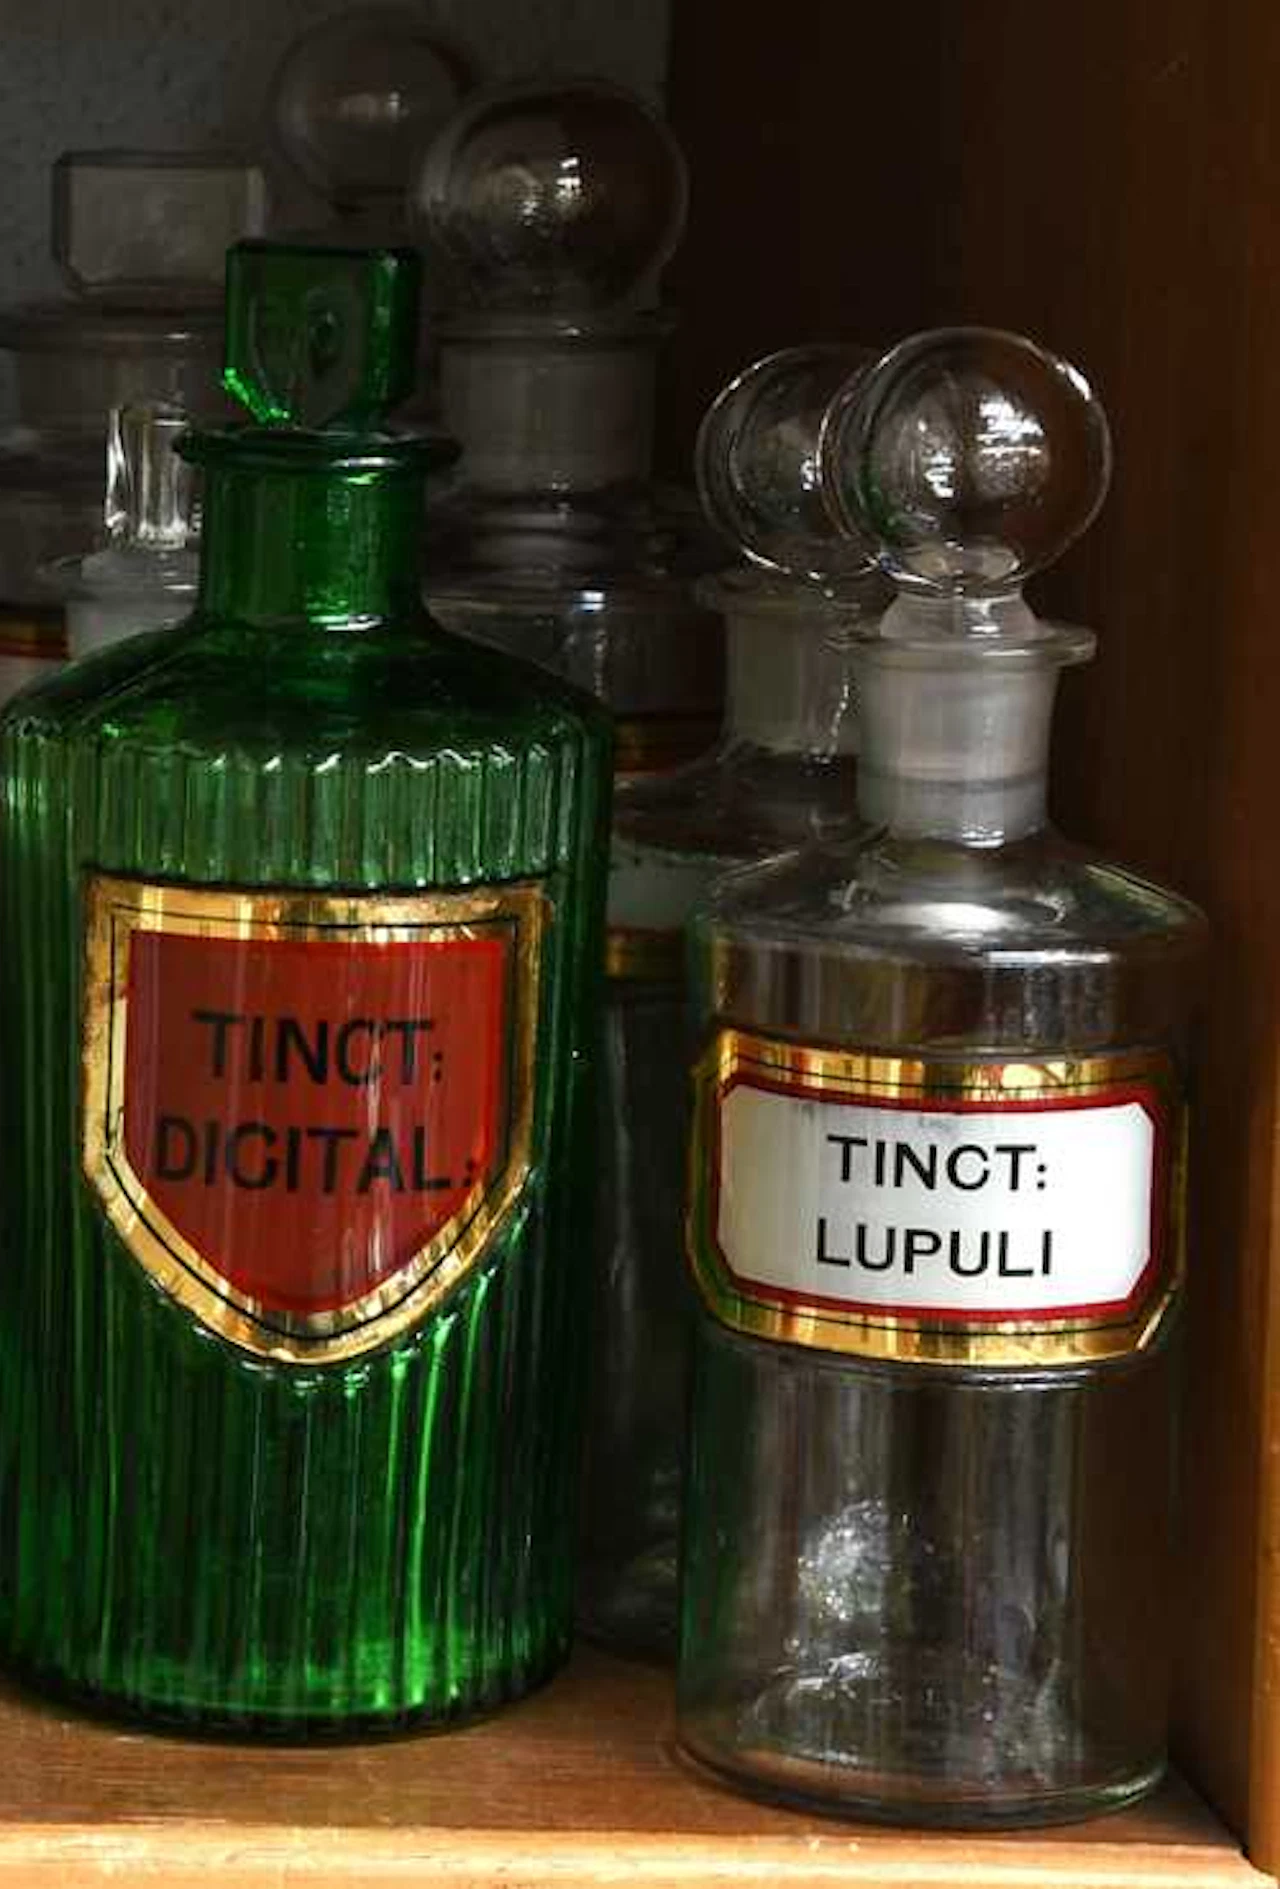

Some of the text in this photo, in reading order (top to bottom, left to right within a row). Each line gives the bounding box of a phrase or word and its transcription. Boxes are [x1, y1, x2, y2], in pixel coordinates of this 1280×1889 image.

[192, 1009, 444, 1087] TINCT:
[827, 1133, 1047, 1191] TINCT:
[816, 1216, 1053, 1278] LUPULI
